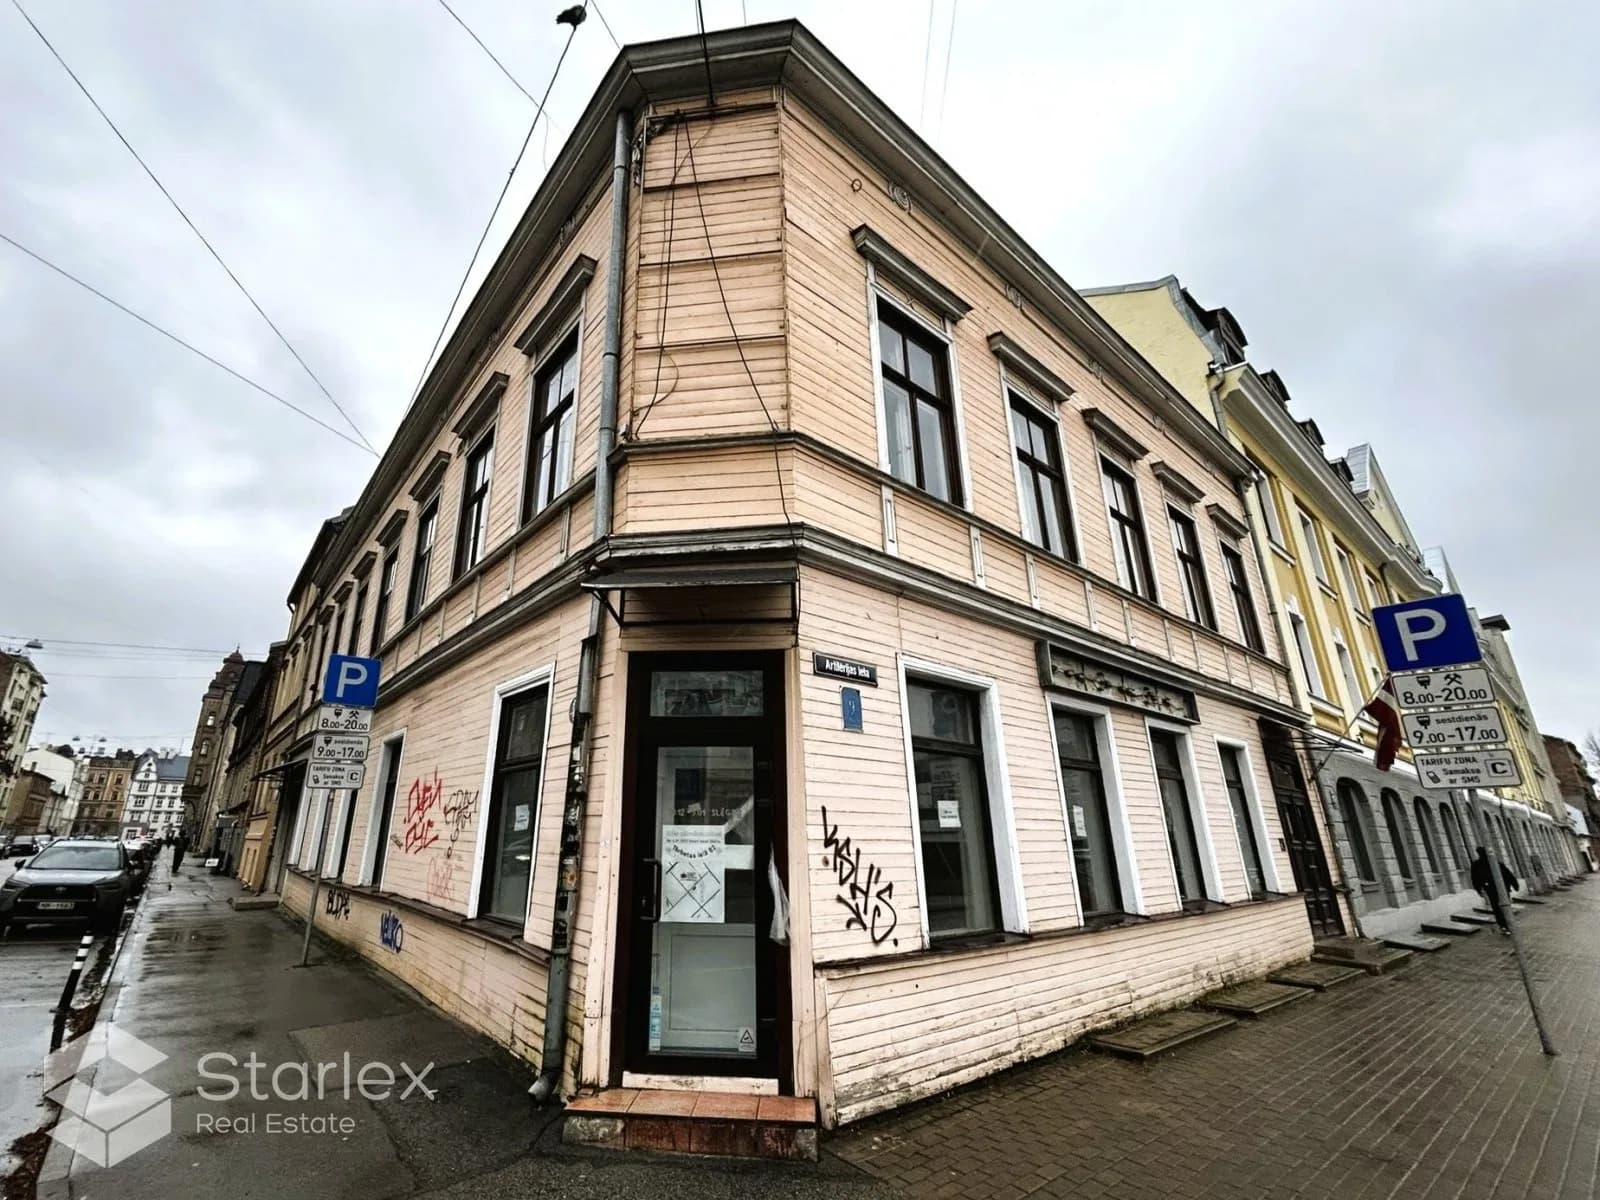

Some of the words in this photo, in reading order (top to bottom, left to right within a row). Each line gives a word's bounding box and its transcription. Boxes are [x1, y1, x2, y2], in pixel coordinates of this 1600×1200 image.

[1393, 608, 1446, 662] P
[336, 661, 368, 698] P
[1403, 687, 1487, 705] 8.00-20.00
[321, 718, 368, 730] 8.00-20.00
[1413, 726, 1498, 744] 9.00-17.00
[317, 746, 364, 758] 9.00-17.00
[1491, 762, 1508, 774] C
[350, 772, 359, 781] C
